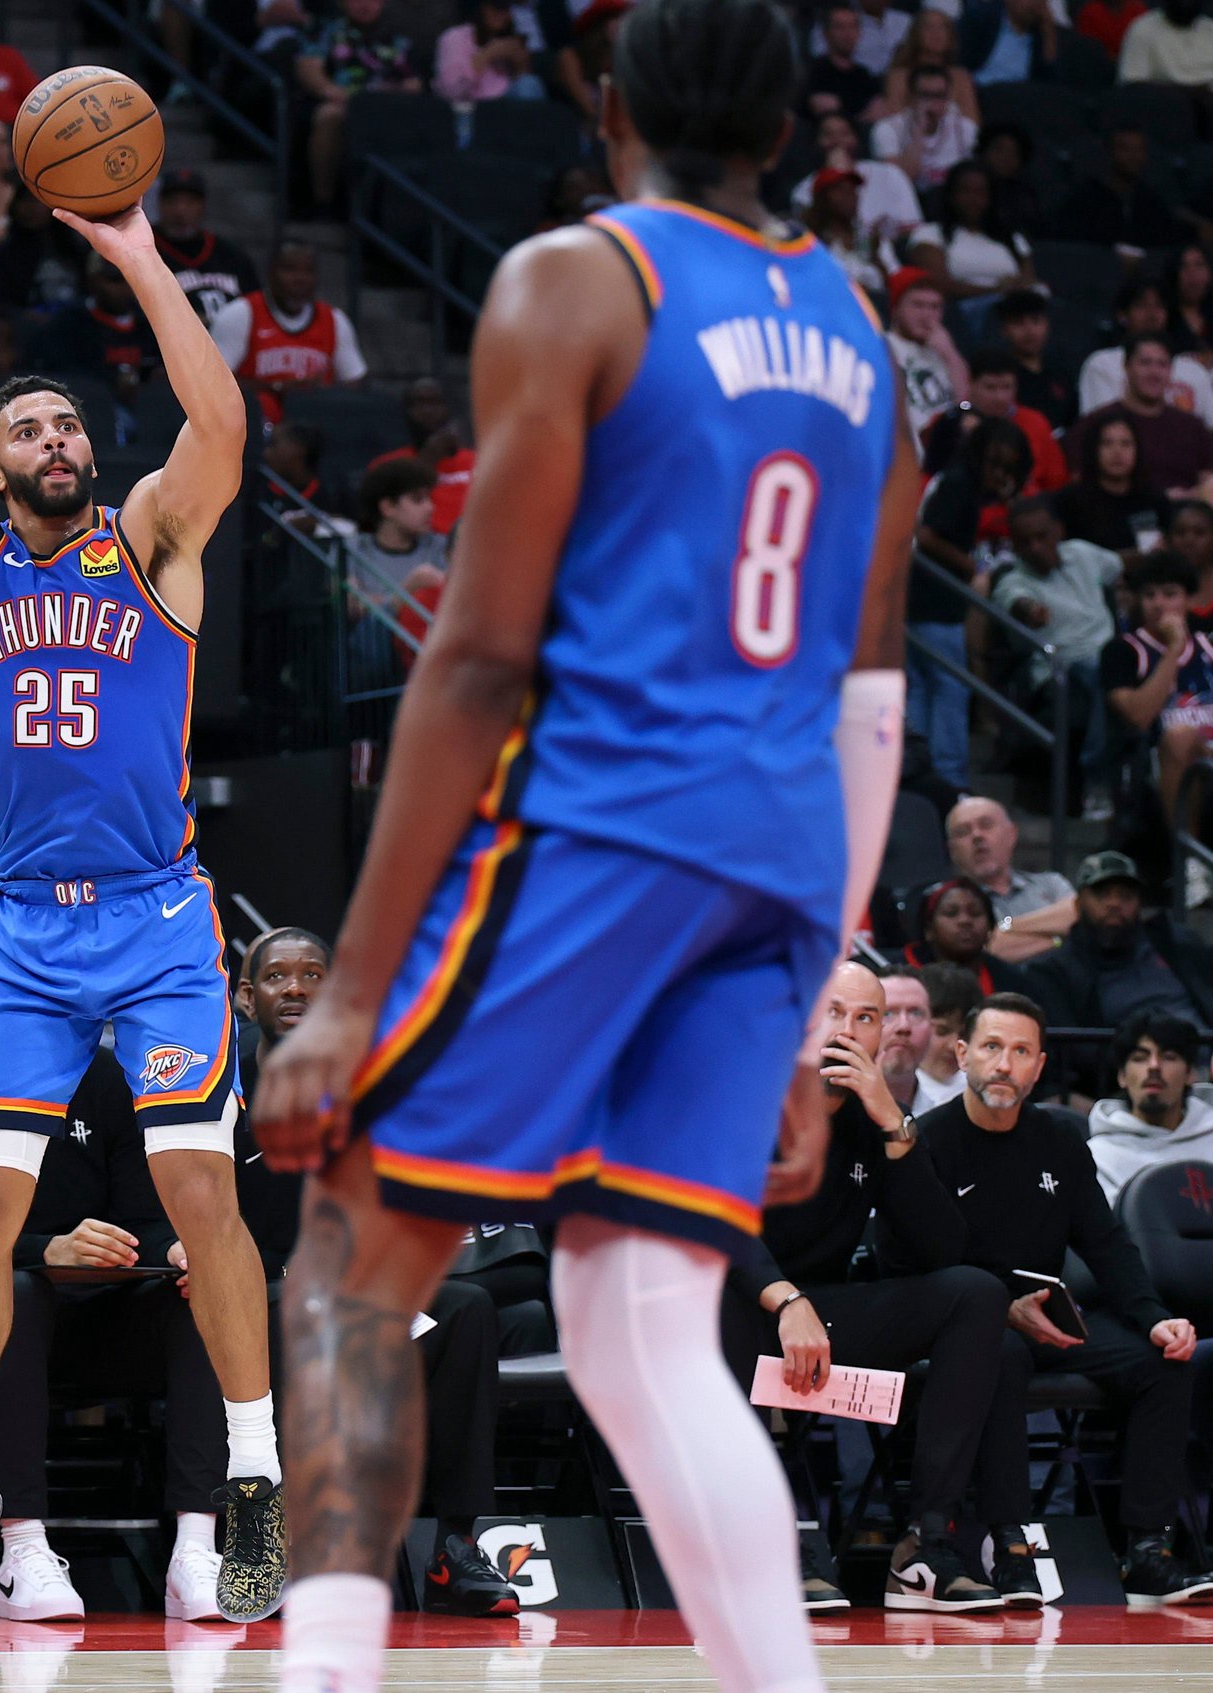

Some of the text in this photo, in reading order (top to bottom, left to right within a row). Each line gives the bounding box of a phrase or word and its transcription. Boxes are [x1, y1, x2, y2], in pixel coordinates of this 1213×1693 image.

[697, 316, 876, 427] WILLIAMS
[730, 449, 822, 670] 8
[13, 667, 100, 749] 25
[55, 879, 96, 906] OKC
